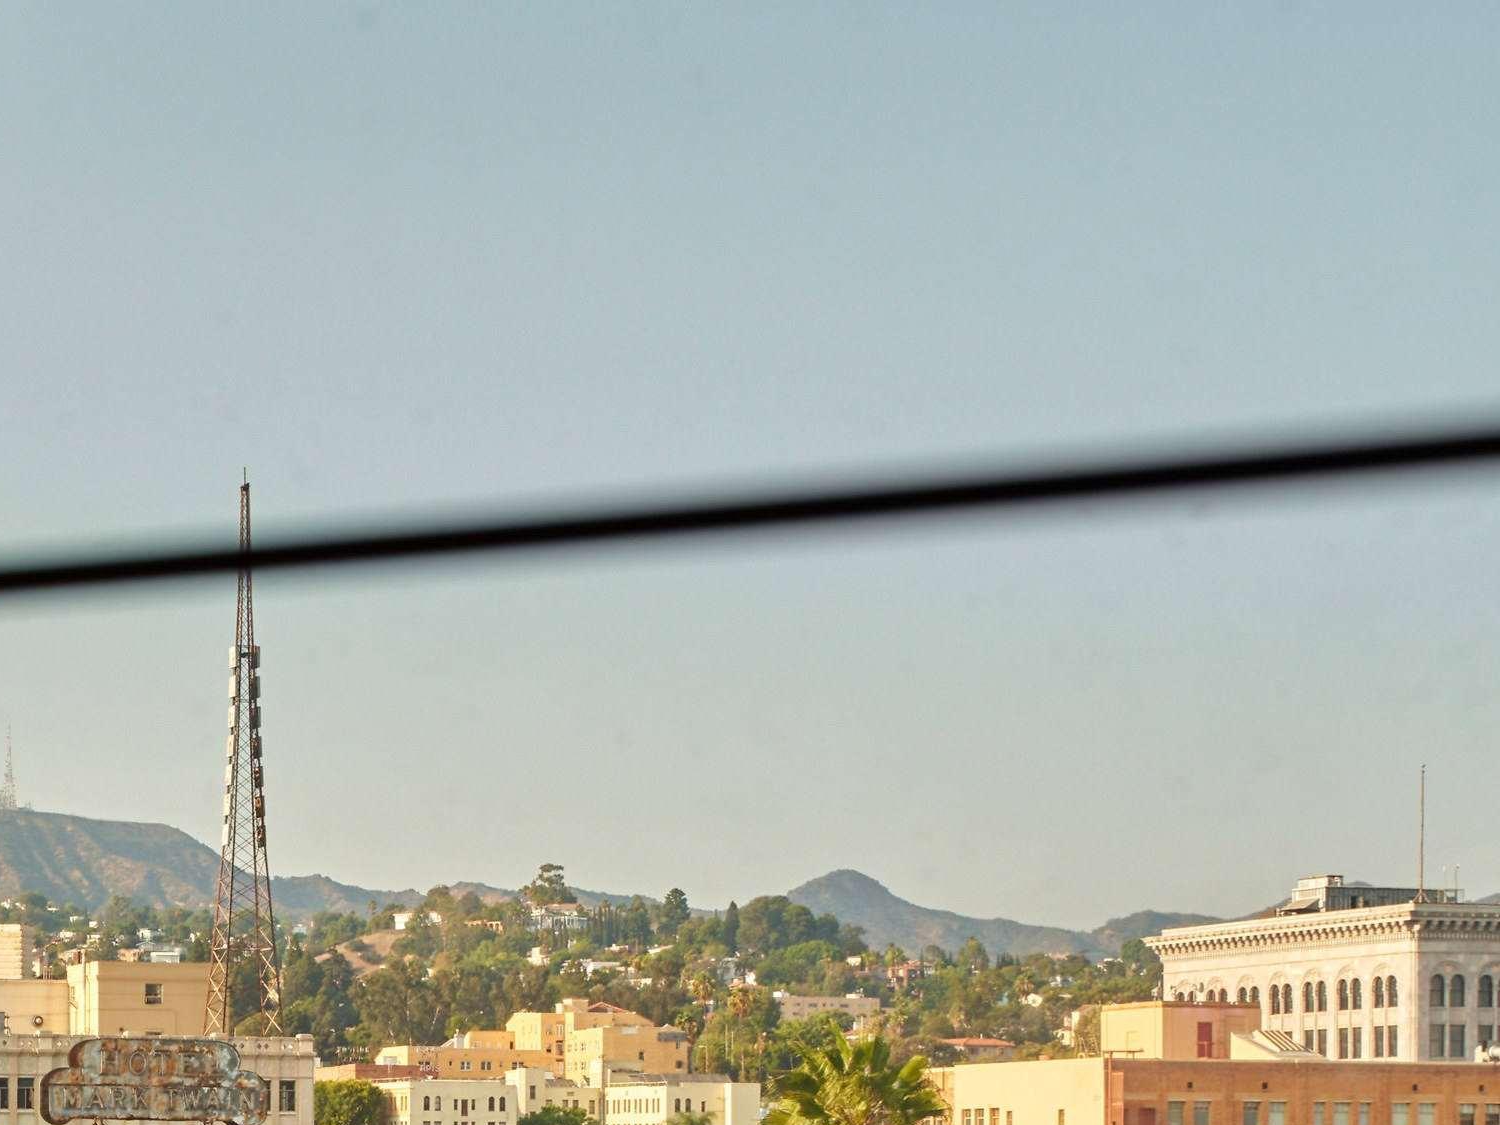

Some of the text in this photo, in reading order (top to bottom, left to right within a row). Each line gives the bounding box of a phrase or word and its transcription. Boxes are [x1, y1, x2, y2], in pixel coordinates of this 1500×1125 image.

[98, 1048, 225, 1077] HOTEL
[61, 1087, 256, 1112] MARK TWAIN
